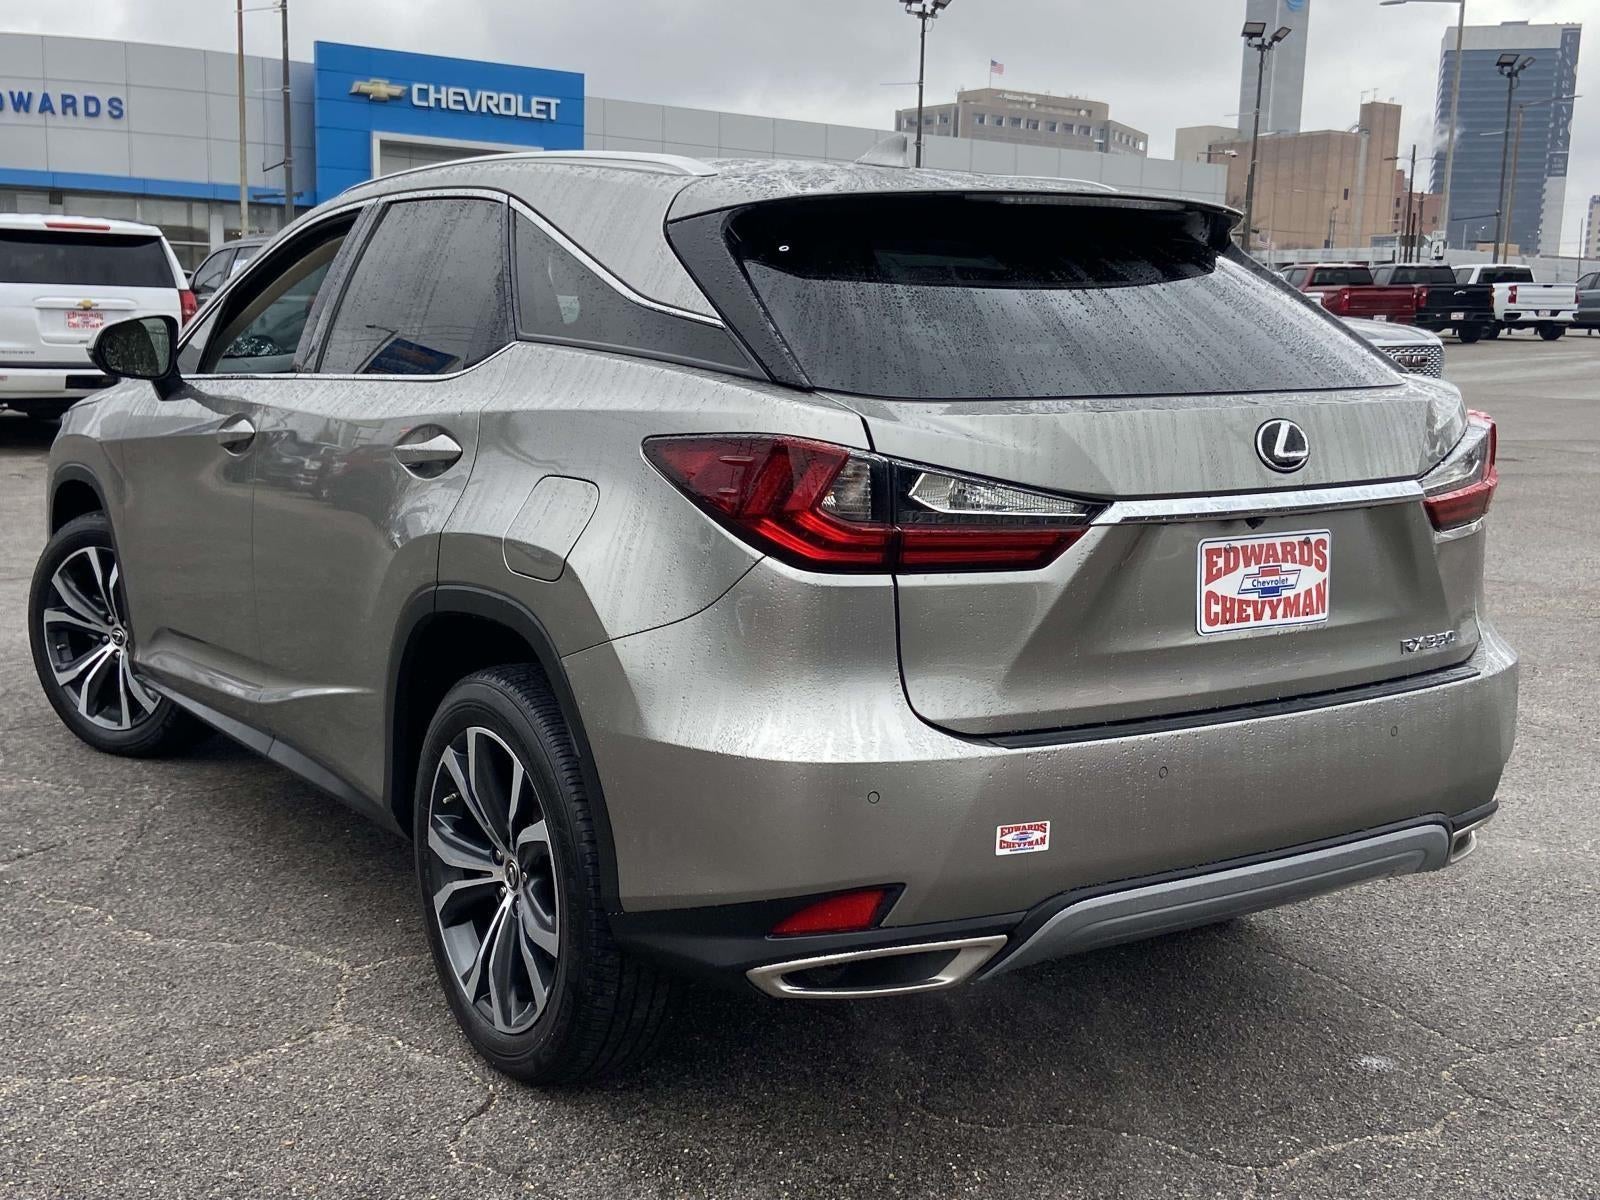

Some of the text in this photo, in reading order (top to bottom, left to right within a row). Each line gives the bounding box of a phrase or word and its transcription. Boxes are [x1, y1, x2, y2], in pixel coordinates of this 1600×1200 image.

[0, 90, 124, 119] WARDS
[411, 82, 561, 121] CHEVROLET
[1205, 538, 1328, 586] EDWARDS
[1251, 577, 1288, 588] Chevrolet
[1205, 577, 1328, 627] CHEVYMAN
[1000, 823, 1047, 838] EDWARDS
[1000, 835, 1046, 849] CHEVYMAN
